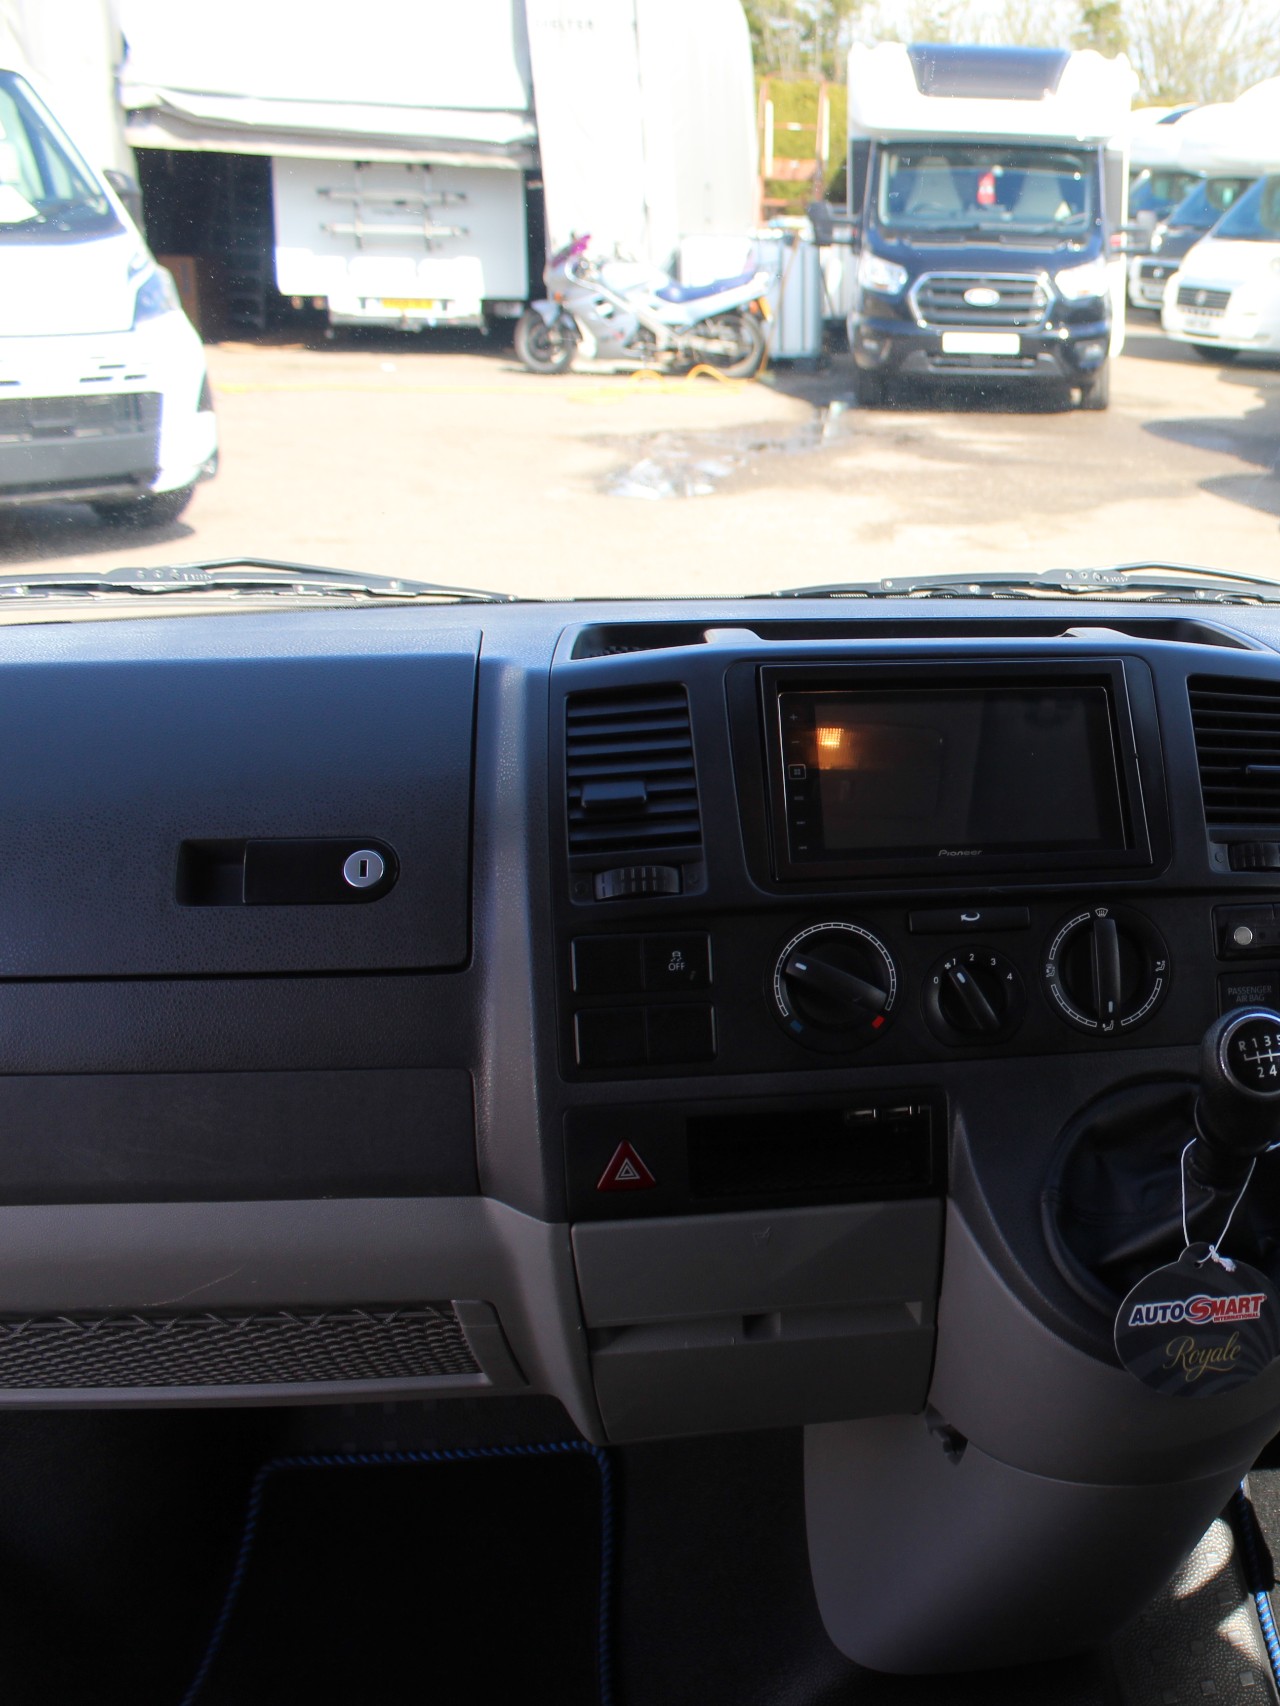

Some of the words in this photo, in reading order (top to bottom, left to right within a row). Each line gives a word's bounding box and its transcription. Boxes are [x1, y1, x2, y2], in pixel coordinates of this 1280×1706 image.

[938, 849, 983, 857] Pioneer
[668, 962, 685, 971] OFF
[933, 976, 939, 984] 0
[952, 958, 956, 966] 1
[969, 953, 975, 961] 2
[990, 958, 996, 966] 3
[1006, 972, 1013, 981] 4
[1228, 985, 1272, 995] PASSENGER
[1236, 994, 1248, 1002] AIR
[1249, 994, 1264, 1002] BAG
[1238, 1041, 1246, 1051] R
[1252, 1038, 1258, 1048] 1
[1264, 1035, 1272, 1046] 3
[1257, 1067, 1265, 1078] 2
[1269, 1064, 1278, 1076] 4
[1162, 1331, 1241, 1382] Royale
